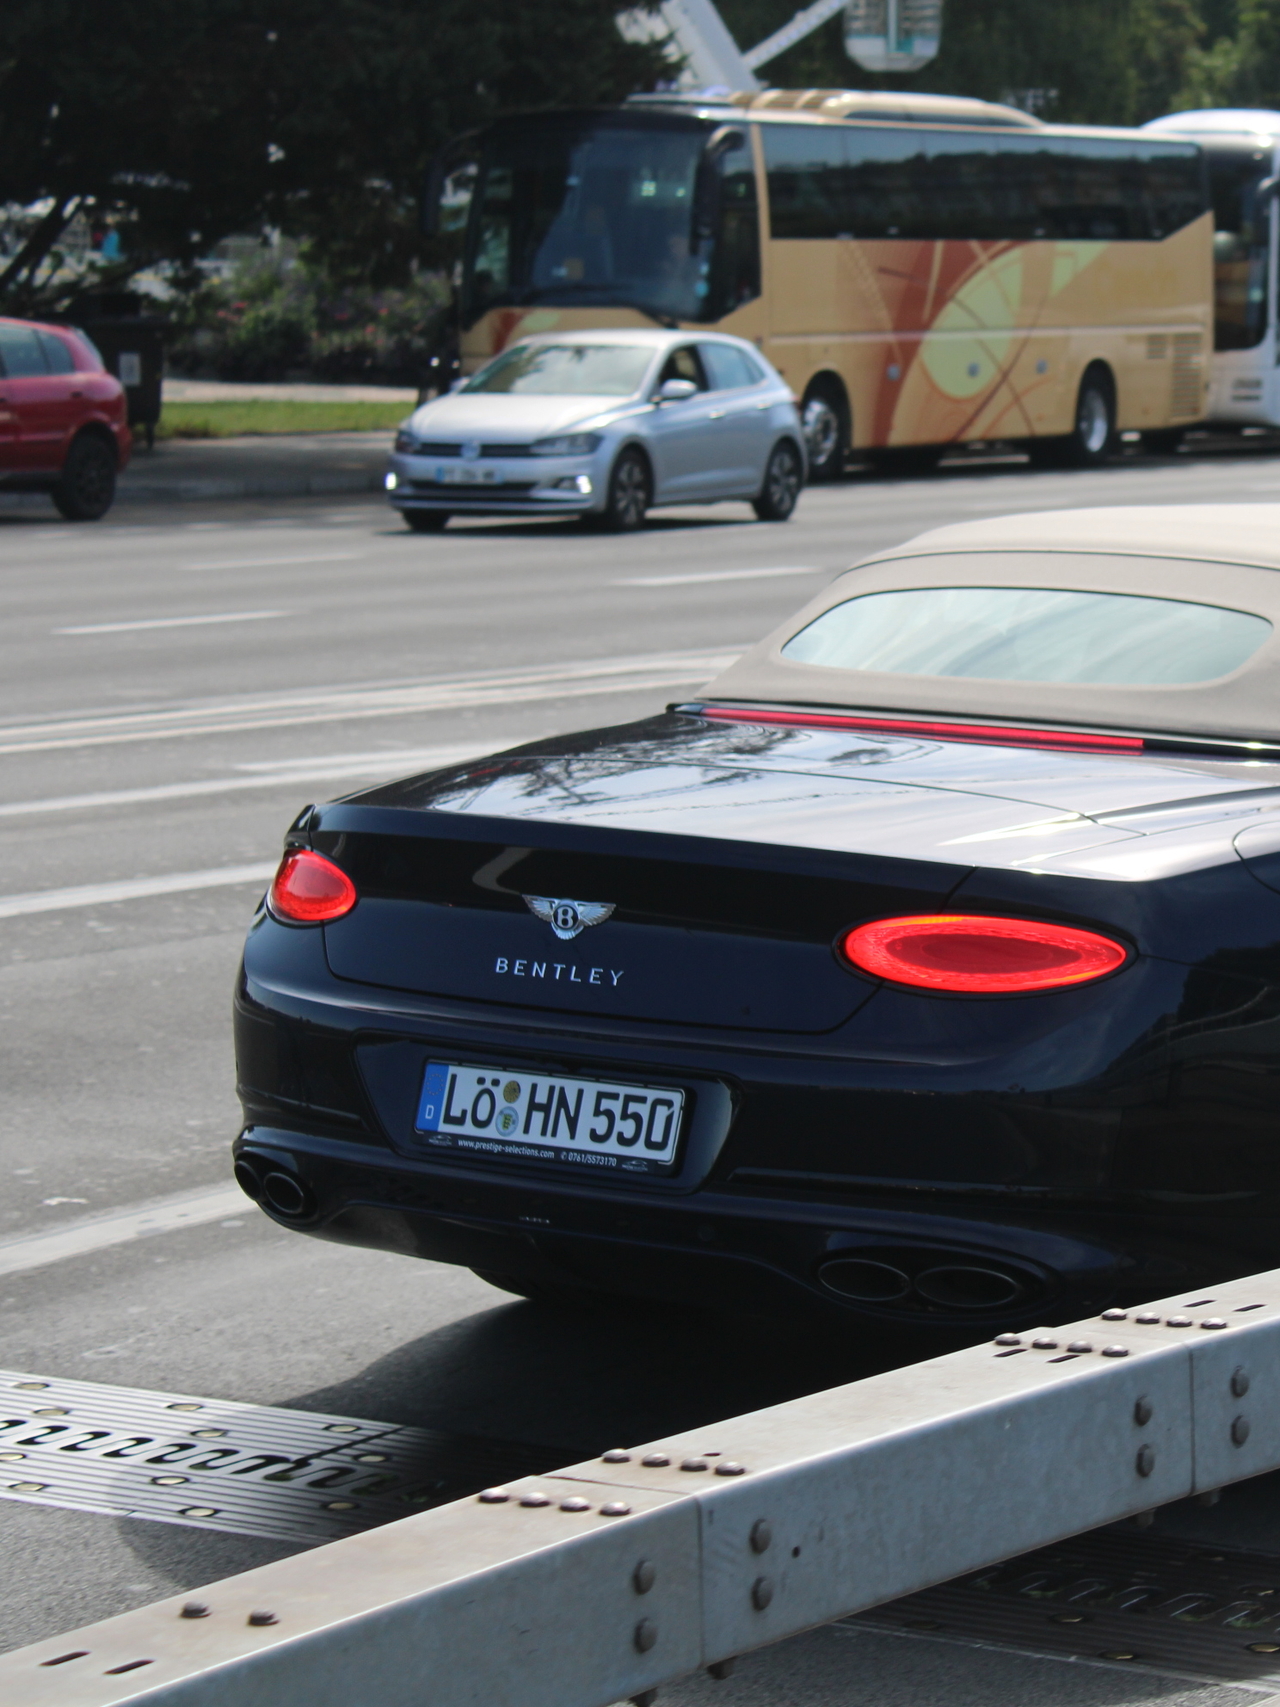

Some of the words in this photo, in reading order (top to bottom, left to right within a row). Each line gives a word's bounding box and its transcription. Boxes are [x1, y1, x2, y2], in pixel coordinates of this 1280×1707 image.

[556, 905, 575, 929] B
[495, 957, 625, 987] BENTLEY
[424, 1104, 435, 1120] D
[442, 1073, 501, 1130] LÖ
[522, 1082, 585, 1141] HN
[588, 1090, 675, 1152] 550
[457, 1138, 555, 1159] www.prestige-selections.com
[568, 1151, 618, 1167] 0761/5573170
